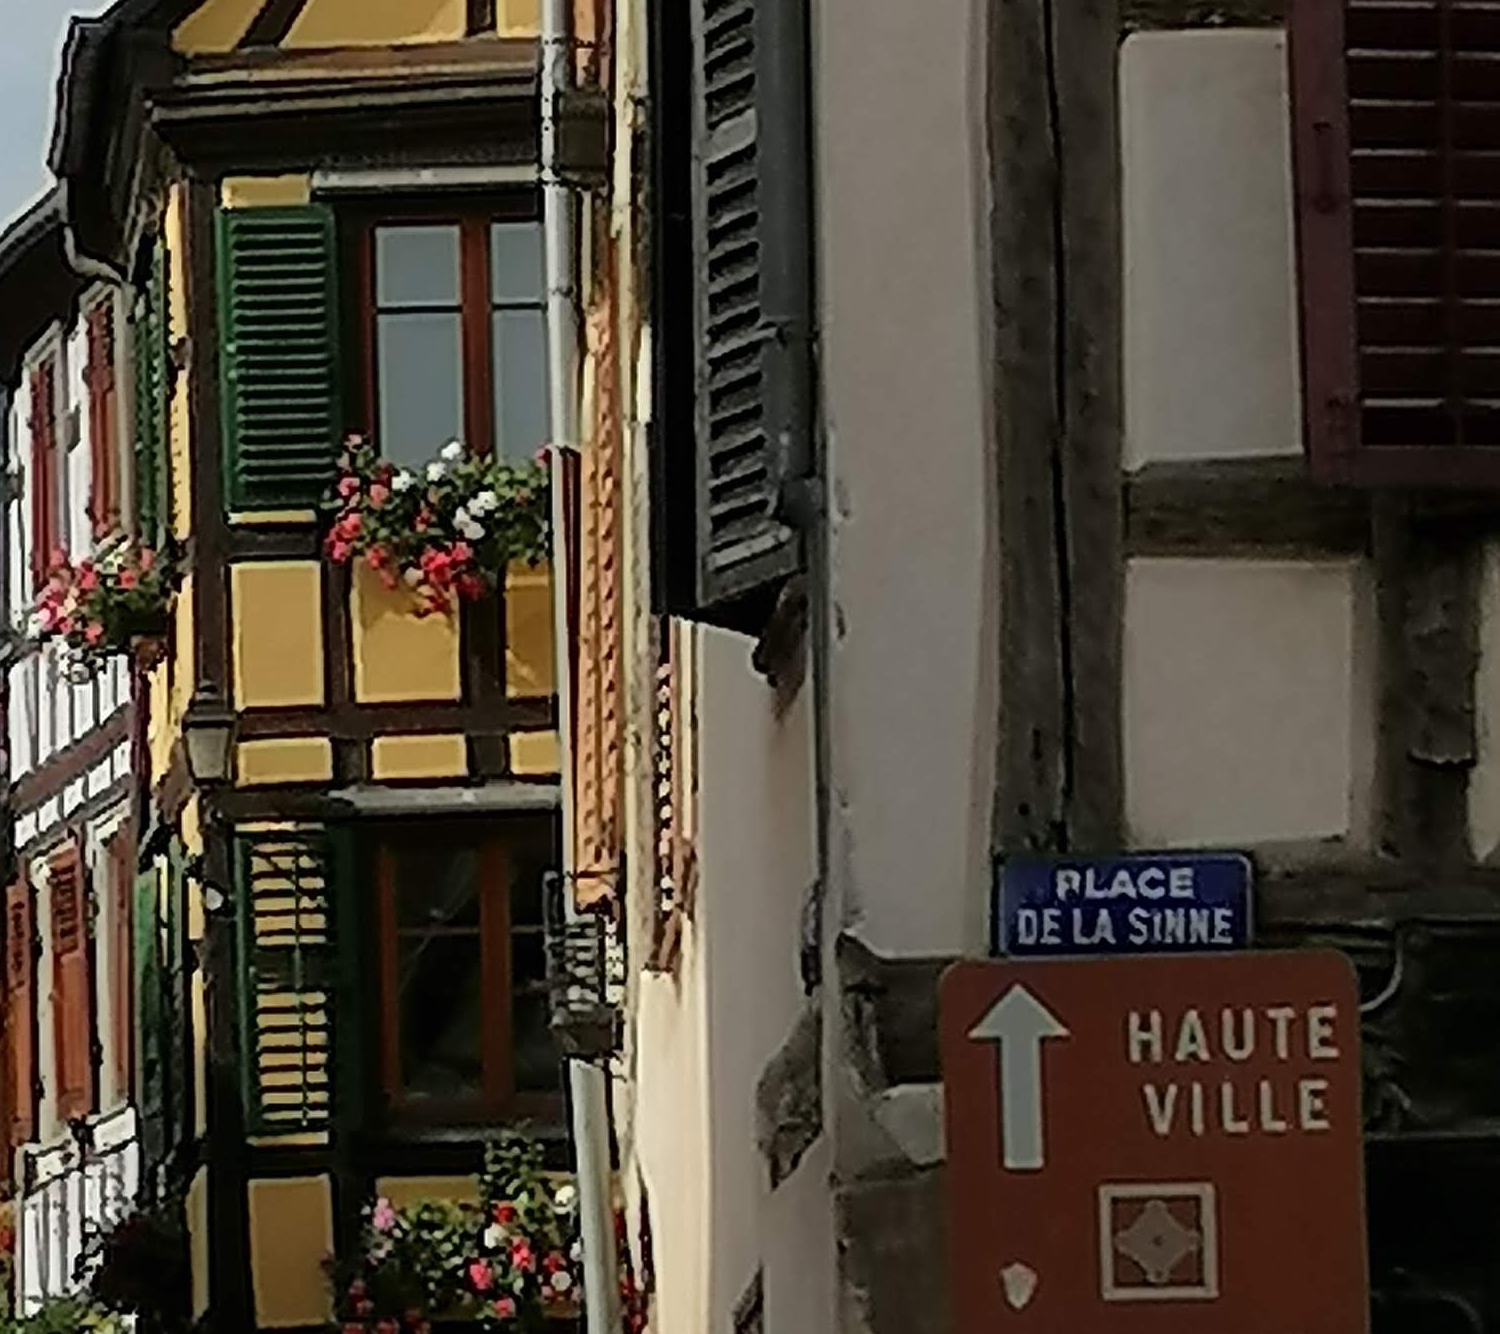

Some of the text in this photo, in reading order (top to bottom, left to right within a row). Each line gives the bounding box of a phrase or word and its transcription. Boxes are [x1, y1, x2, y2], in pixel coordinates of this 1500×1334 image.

[1056, 867, 1195, 900] PLACE
[1017, 907, 1234, 945] DE LA SINNE
[1128, 1004, 1341, 1063] HAUTE
[1143, 1078, 1331, 1136] VILLE
